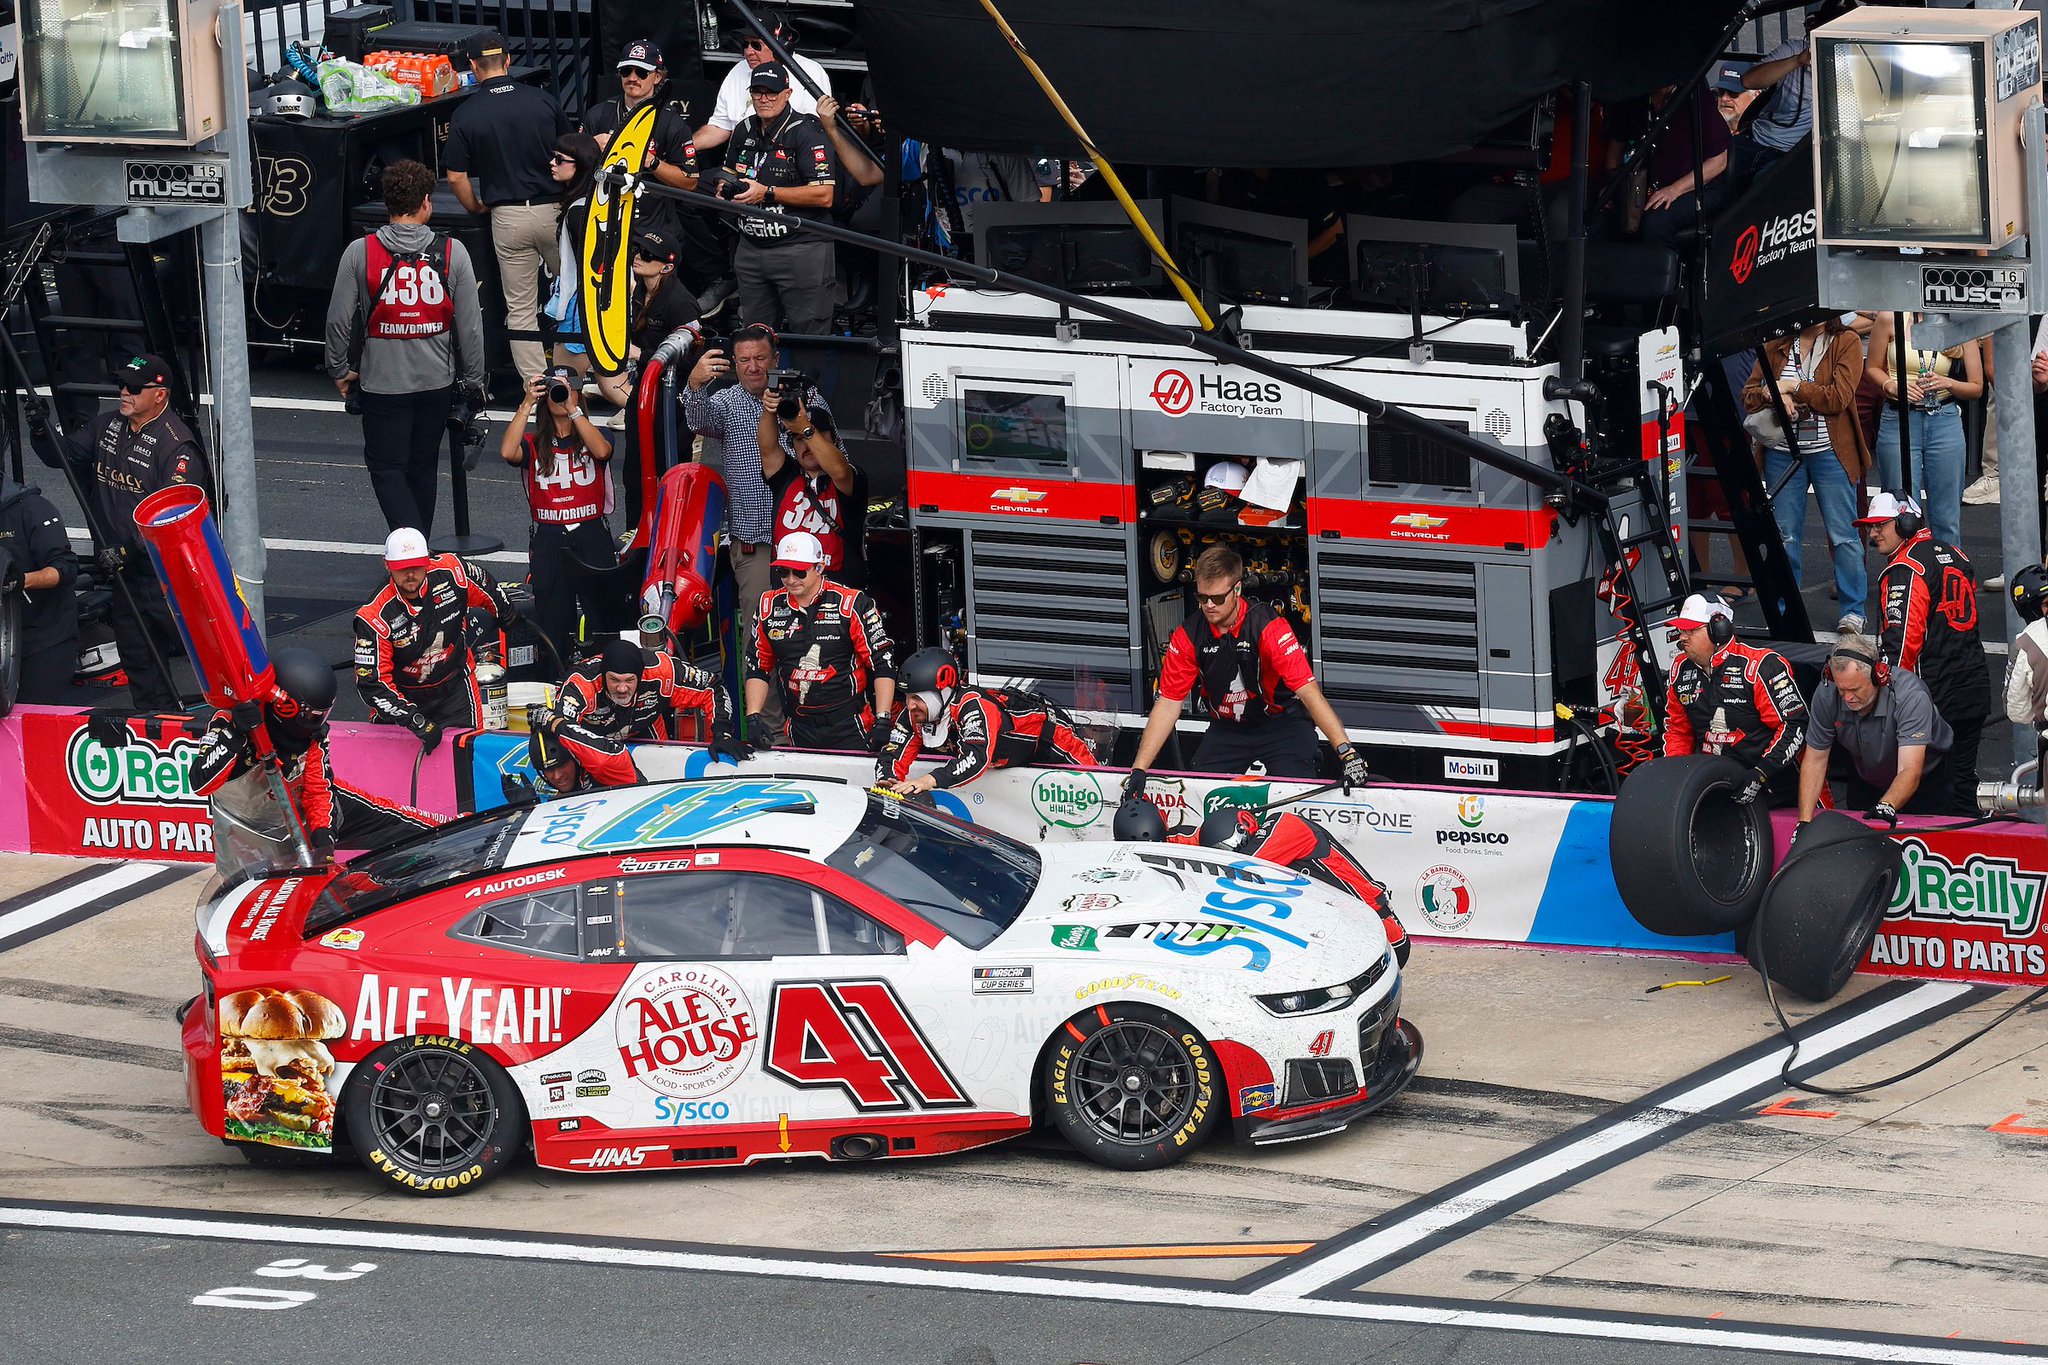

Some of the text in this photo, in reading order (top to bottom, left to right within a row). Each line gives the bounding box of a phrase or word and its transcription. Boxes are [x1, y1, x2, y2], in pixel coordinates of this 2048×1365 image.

[199, 165, 216, 178] 15
[129, 180, 220, 198] musco
[1758, 207, 1817, 252] Haas
[1756, 237, 1815, 268] Factory Team
[380, 265, 445, 305] 438
[2000, 270, 2017, 283] 16
[1925, 285, 2021, 304] musco
[379, 321, 444, 335] TEAM/DRIVER
[1199, 373, 1283, 403] Haas
[1200, 401, 1283, 418] Factory Team
[96, 461, 143, 489] LEGACY
[536, 503, 597, 521] TEAM/DRIVER
[990, 504, 1049, 514] CHEVROLET
[1389, 530, 1450, 540] CHEVROLET
[767, 618, 787, 629] Sysco
[372, 695, 409, 717] HAAS
[201, 743, 229, 770] HAAS
[1782, 726, 1804, 765] HAAS
[77, 737, 200, 795] ORei
[952, 750, 977, 776] HAAS
[1448, 761, 1494, 777] Mobil 1
[1039, 783, 1099, 812] bibigo
[540, 799, 608, 845] Sysco
[578, 780, 819, 850] 41
[1293, 806, 1413, 829] KEYSTONE
[82, 817, 216, 853] AUTO PAR
[1436, 828, 1510, 846] pepsico
[1445, 846, 1504, 856] Food. Drinks. Smiles.
[620, 858, 691, 873] CUSTER
[1422, 866, 1466, 884] LA BANDERITA
[483, 867, 568, 895] AUTODESK
[1153, 860, 1311, 973] Sysco
[1420, 907, 1473, 931] AUTHENTIC TORTILLAS
[1059, 925, 1086, 948] Knorr
[587, 947, 615, 957] HAAS
[1869, 932, 2047, 976] AUTO PARTS
[981, 980, 1025, 989] CUP SERIES
[991, 968, 1025, 978] NASCAR
[644, 970, 737, 1009] CAROLINA
[1074, 973, 1183, 1001] GOODYEAR
[351, 973, 563, 1044] ALE YEAH!
[625, 992, 710, 1042] ALE
[414, 1034, 474, 1055] EAGLE
[617, 1011, 759, 1079] HOUSE
[761, 977, 978, 1114] 41
[1308, 1028, 1335, 1058] 41
[578, 1069, 605, 1083] BONANZA
[651, 1062, 735, 1091] FOOD SPORTS FUN
[1053, 1044, 1073, 1104] EAGLE
[1171, 1032, 1212, 1147] GOODYEAR
[1242, 1091, 1274, 1107] SUNOCO
[655, 1096, 729, 1125] Sysco
[560, 1119, 579, 1131] SEM
[368, 1146, 483, 1191] GOODYEAR
[569, 1144, 670, 1168] HAAS
[190, 1258, 379, 1311] 30
